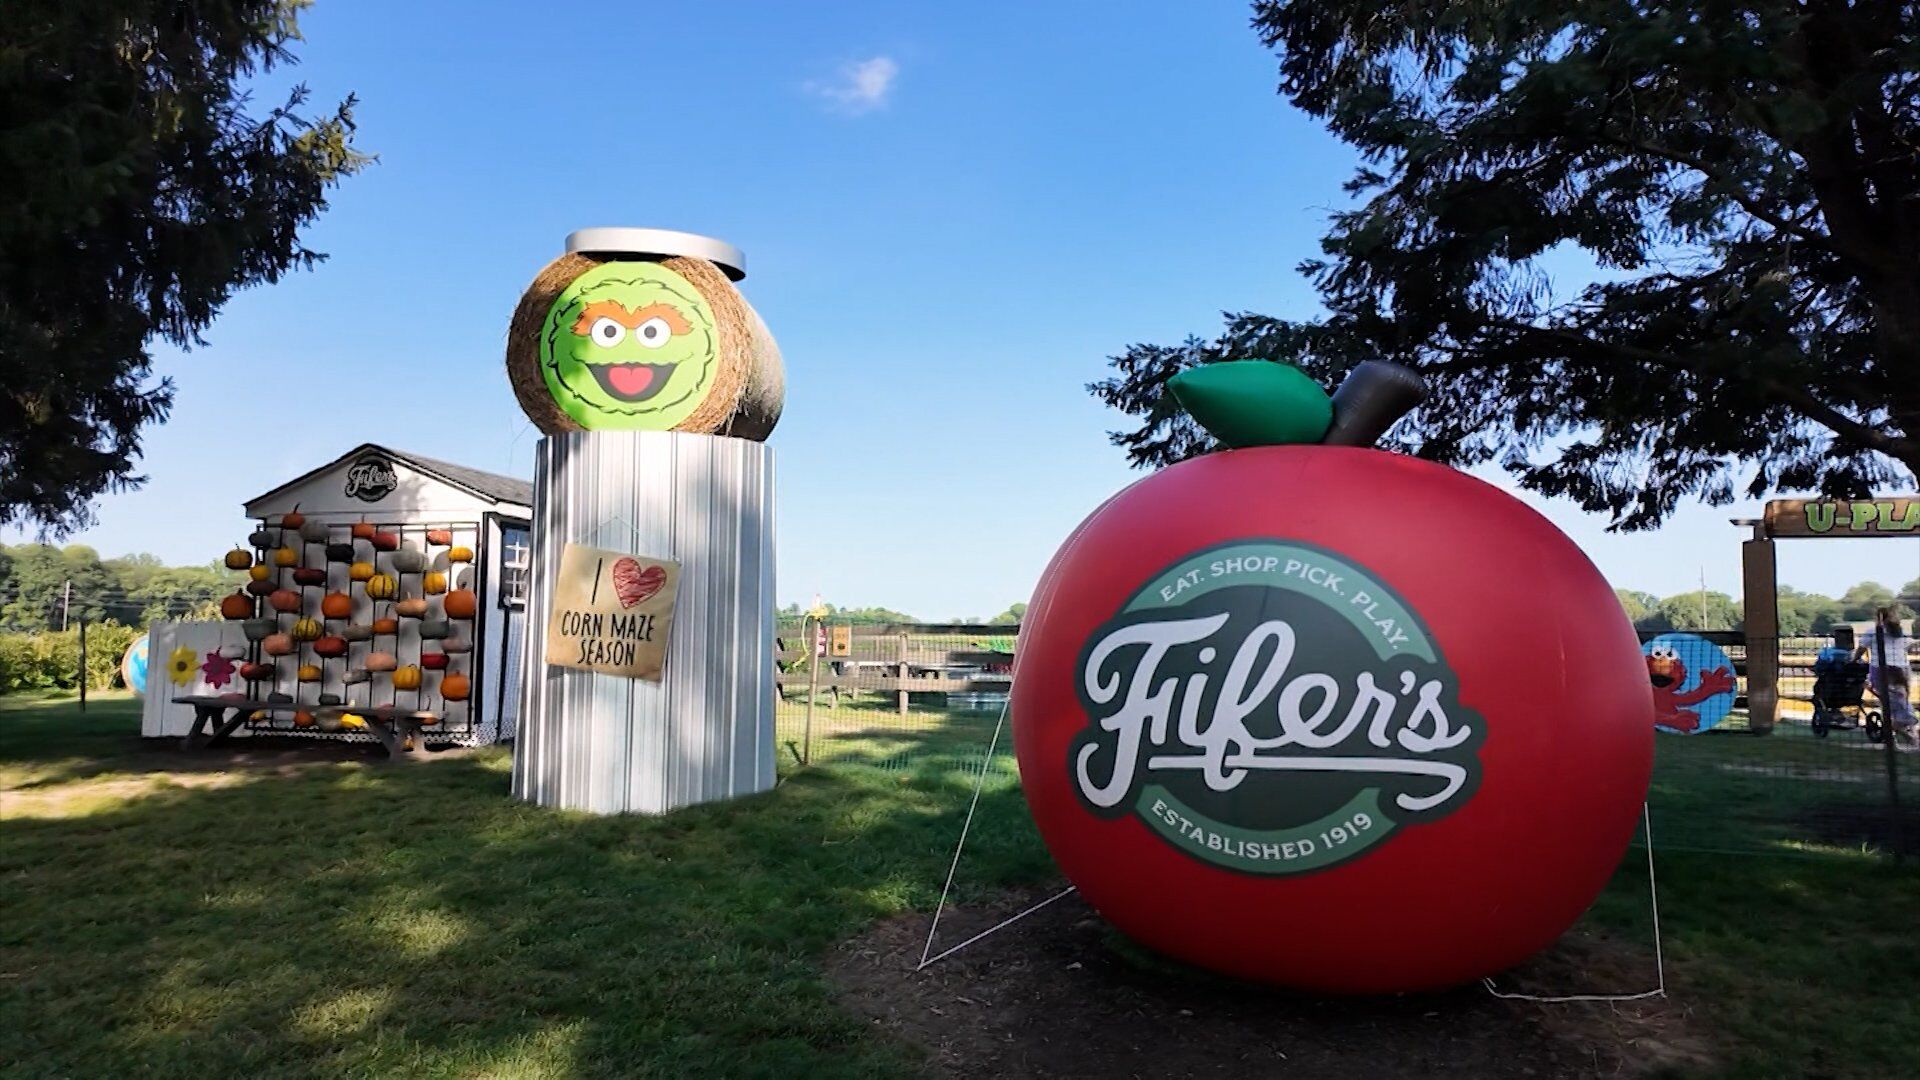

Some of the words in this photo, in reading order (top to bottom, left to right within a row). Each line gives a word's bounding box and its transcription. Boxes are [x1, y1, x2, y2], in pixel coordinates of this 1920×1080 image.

[591, 557, 603, 606] I
[1159, 569, 1205, 602] EAT.
[1283, 559, 1345, 596] PICK.
[1350, 591, 1409, 650] PLAY.
[561, 609, 604, 638] CORN
[610, 613, 656, 642] MAZE
[577, 639, 636, 666] SEASON
[1076, 612, 1472, 808] Fifer's
[1151, 799, 1315, 860] ESTABLISHED
[1320, 812, 1373, 849] 1919
